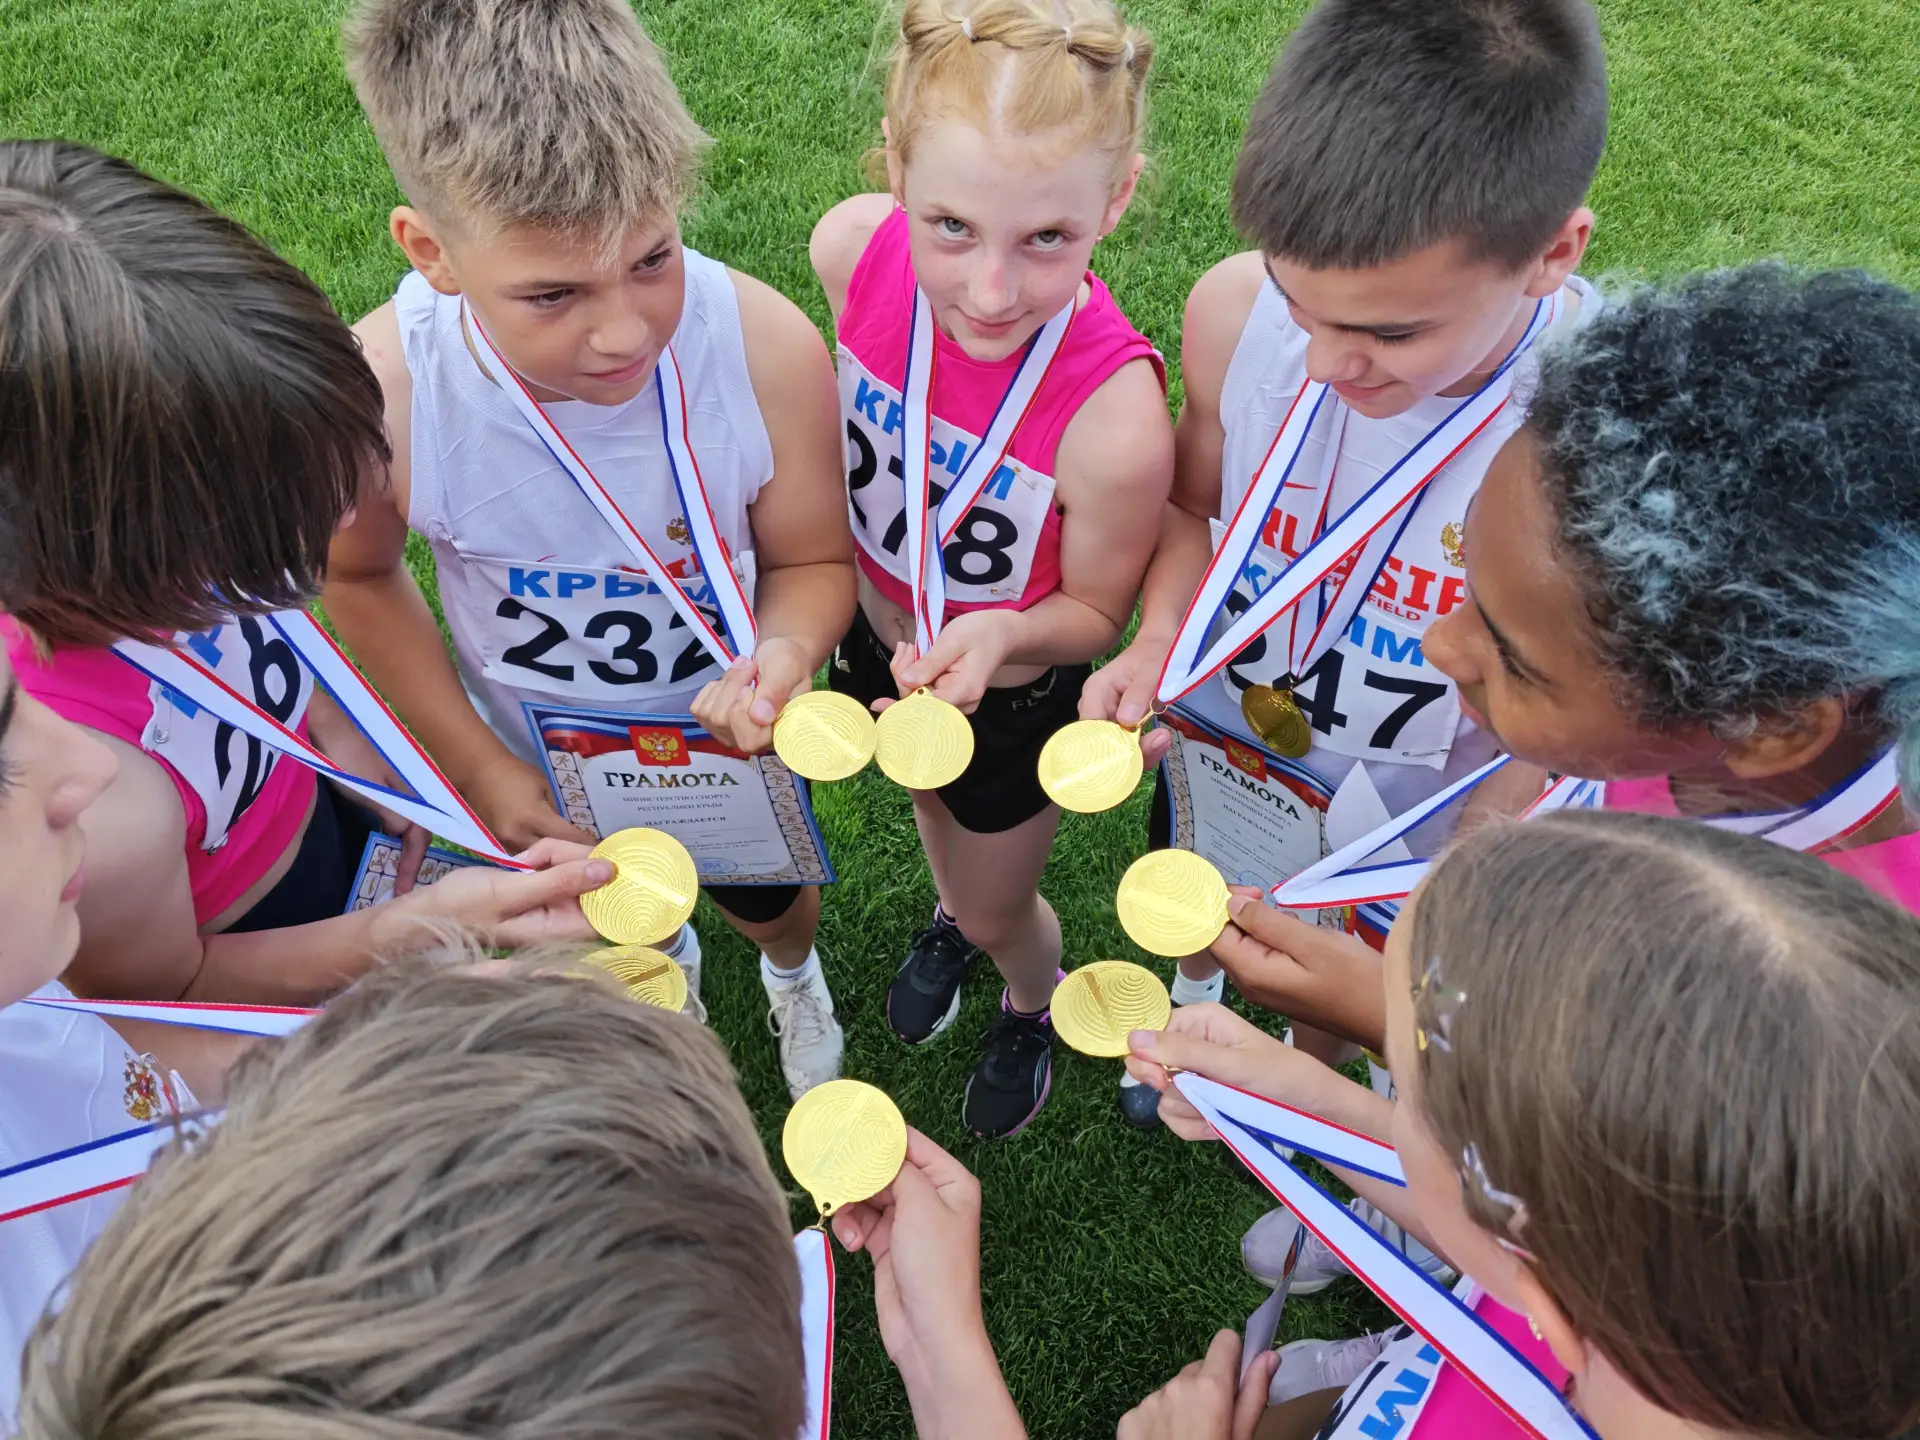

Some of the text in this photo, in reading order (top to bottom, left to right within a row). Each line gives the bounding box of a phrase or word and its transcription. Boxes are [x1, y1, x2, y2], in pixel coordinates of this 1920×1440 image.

[1366, 594, 1422, 622] FIELD
[495, 597, 729, 686] 232
[602, 771, 741, 788] ГРАМОТА
[1199, 751, 1303, 822] ГРАМОТА
[1210, 776, 1264, 810] МИНИСТЕРСТВО
[622, 792, 732, 803] МИНИСТЕРСТВО СПОРТА
[637, 802, 723, 812] РЕСПУБЛИКИ КРЫМ
[644, 815, 727, 826] НАГРАЖДАЕТСЯ
[1222, 802, 1284, 845] НАГРАЖДАЕТСЯ
